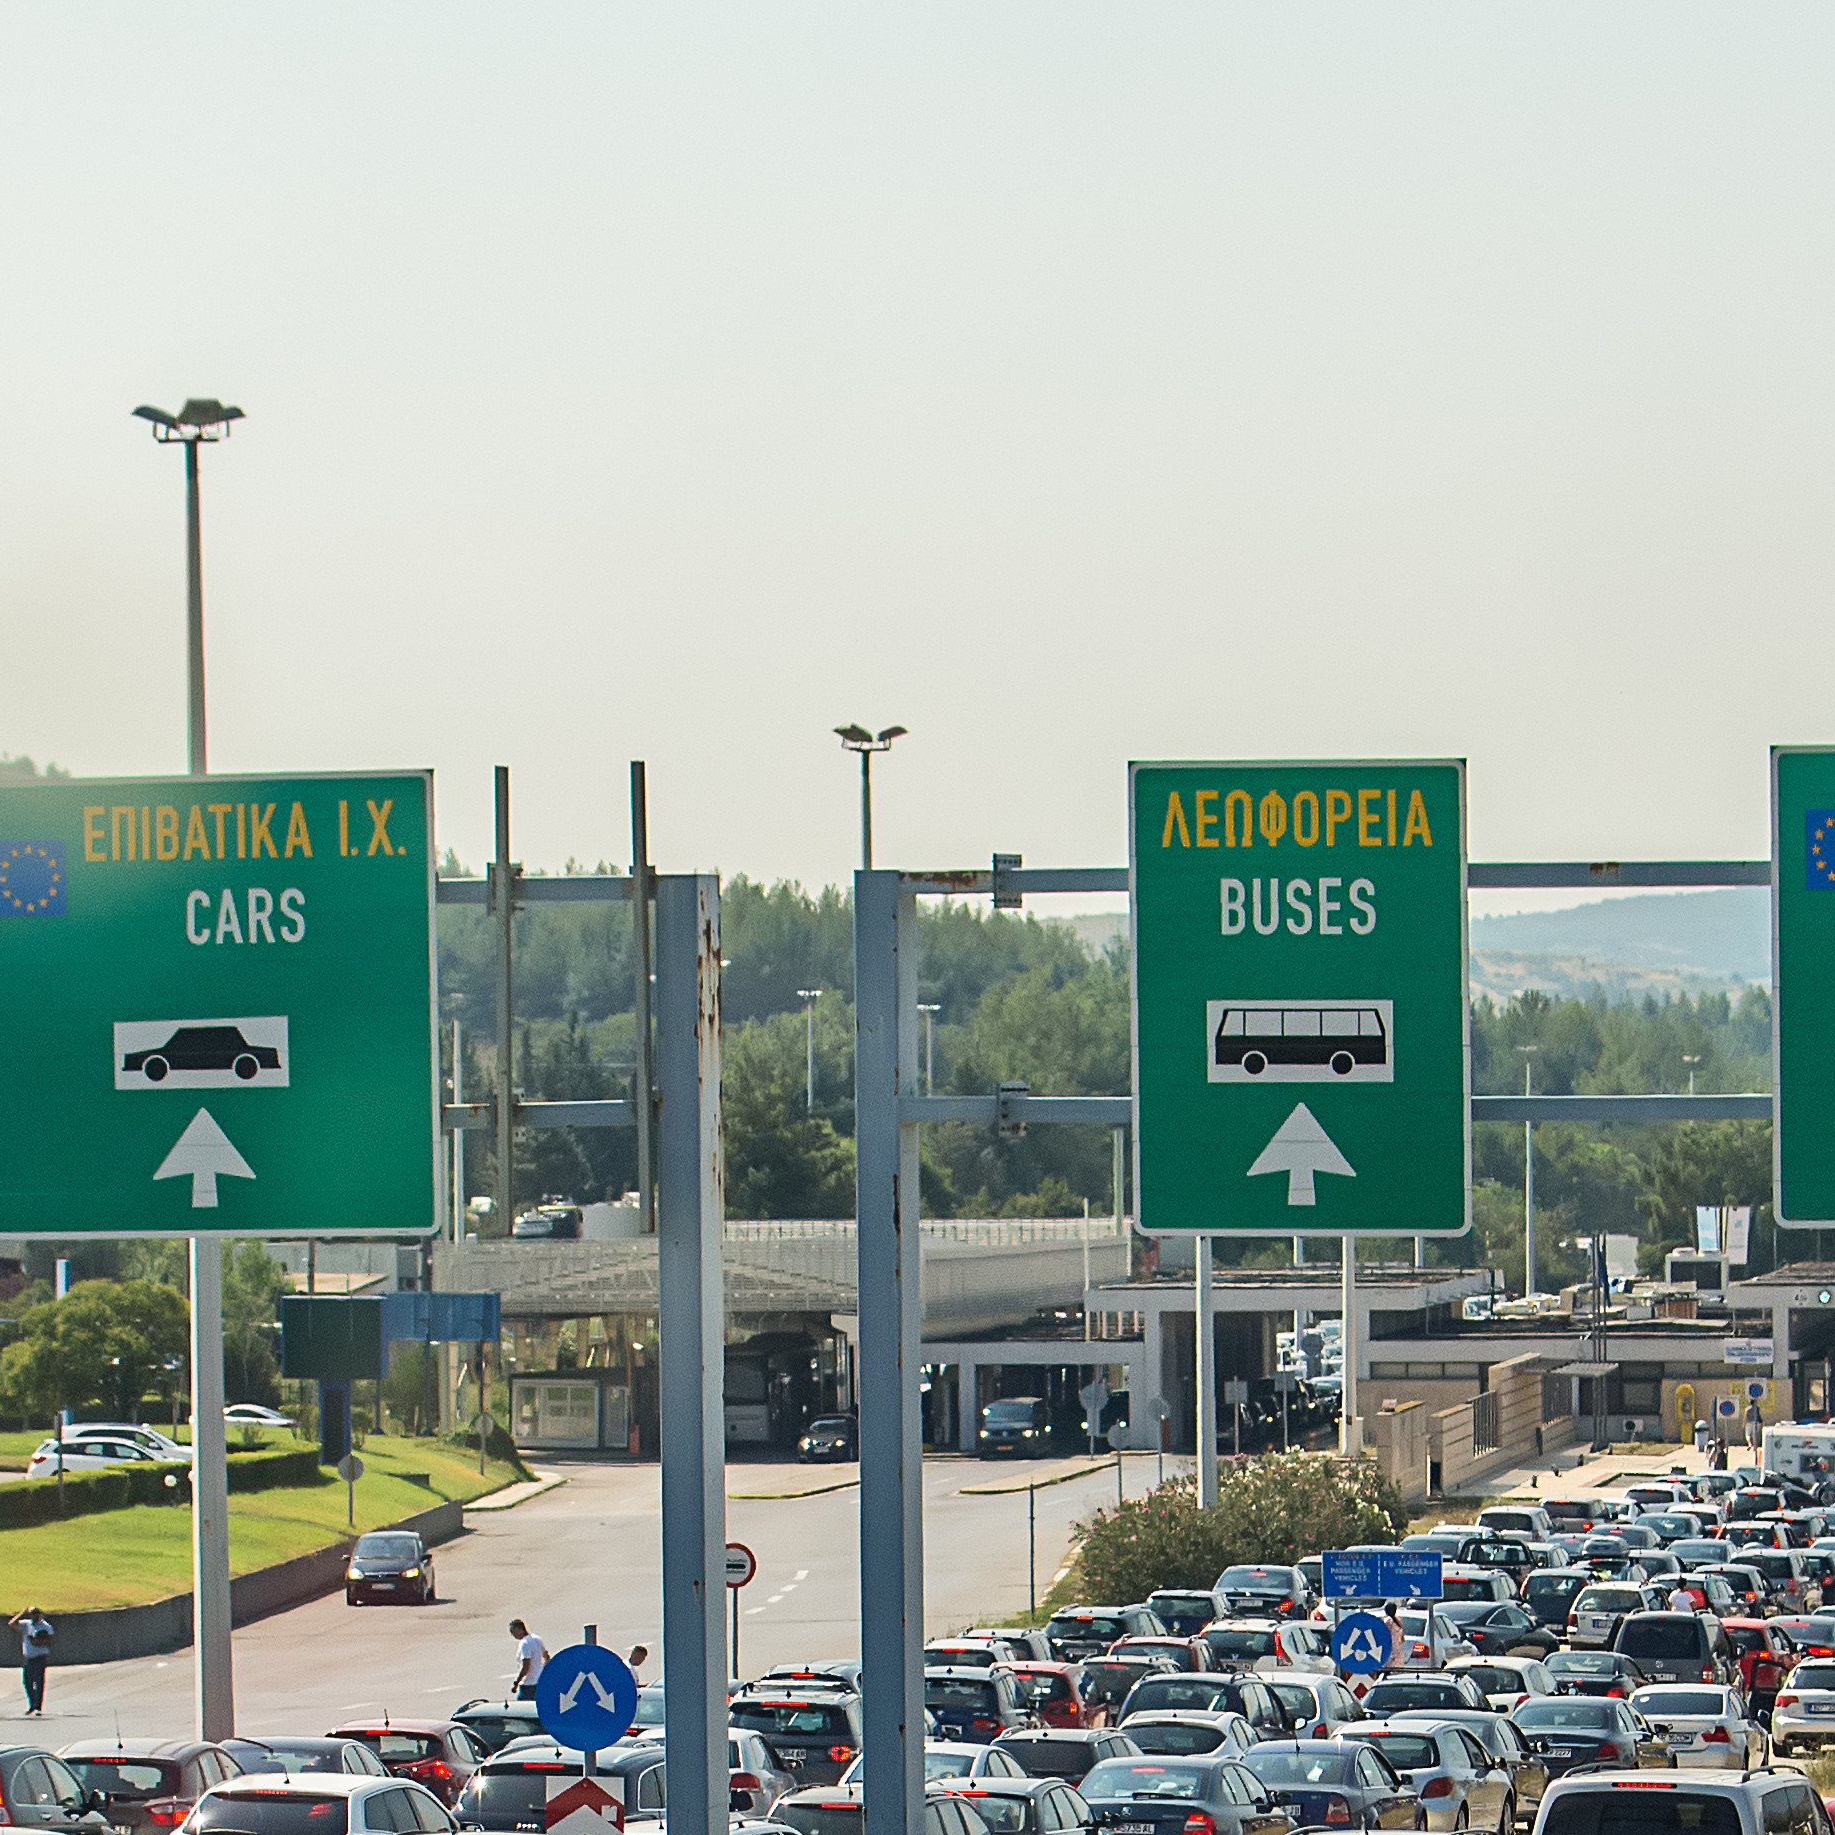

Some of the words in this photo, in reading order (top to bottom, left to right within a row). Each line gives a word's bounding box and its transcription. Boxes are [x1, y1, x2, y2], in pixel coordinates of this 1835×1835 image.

[83, 802, 313, 862] ΕΠΙΒΑΤΙΚΑ
[1162, 789, 1433, 848] ΛΕΩΦΟΡΕΙΑ
[185, 887, 306, 945] CARS
[1220, 877, 1376, 936] BUSES
